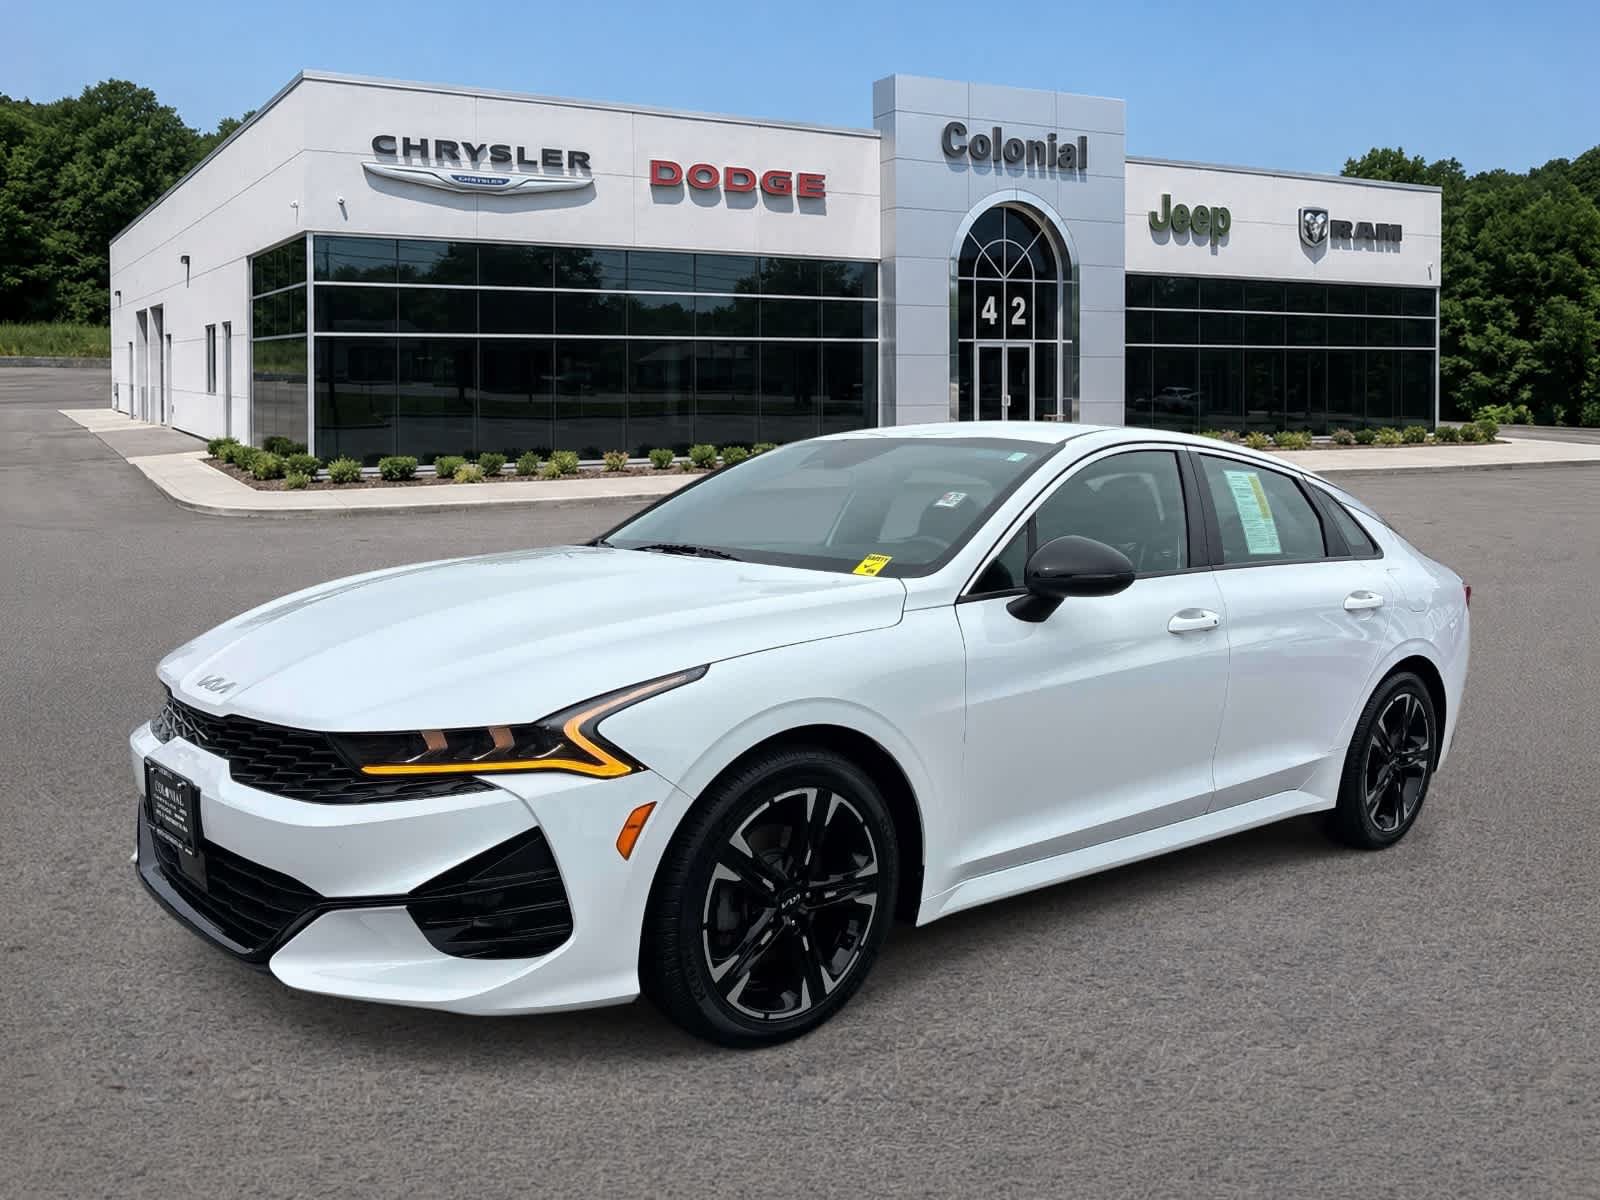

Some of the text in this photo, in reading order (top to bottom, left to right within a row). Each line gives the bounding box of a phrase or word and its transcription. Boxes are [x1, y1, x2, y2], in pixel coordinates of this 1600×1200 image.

[371, 134, 592, 169] CHRYSLER
[941, 121, 1088, 170] Colonial
[650, 159, 826, 198] DODGE
[1148, 193, 1232, 247] Jeep
[1330, 219, 1403, 242] RAM
